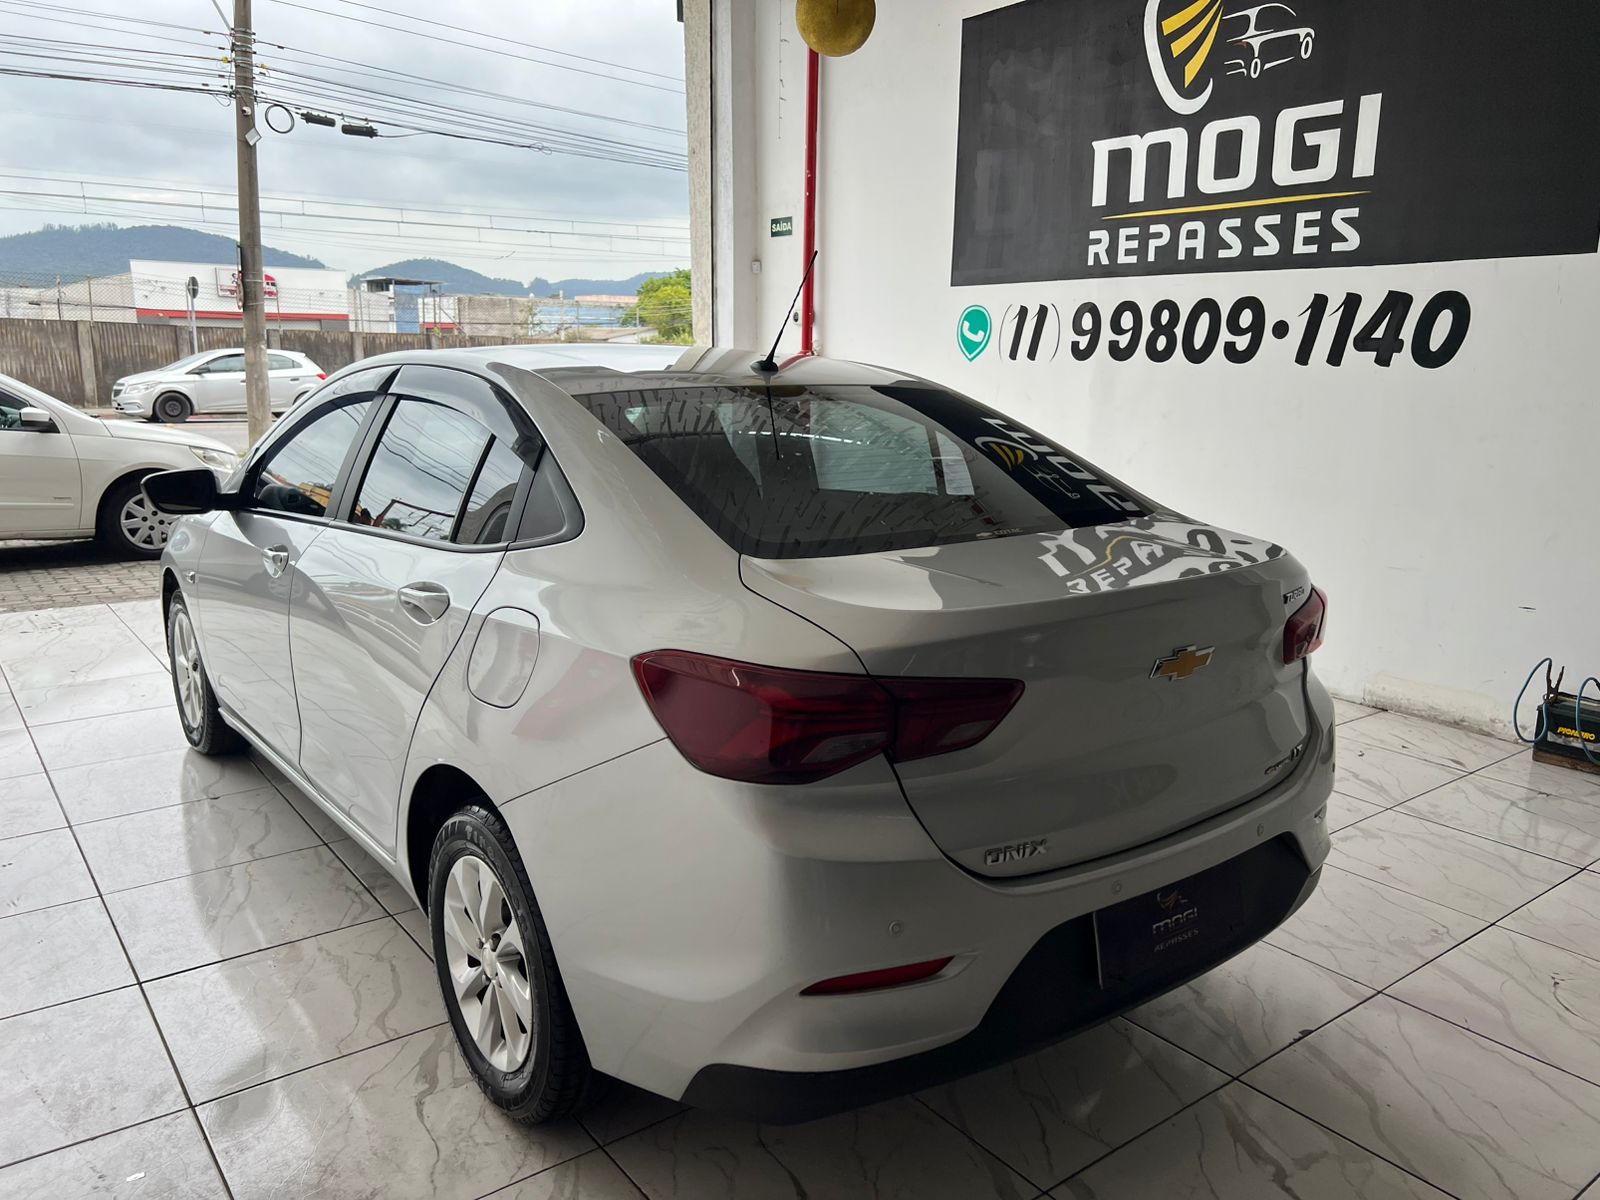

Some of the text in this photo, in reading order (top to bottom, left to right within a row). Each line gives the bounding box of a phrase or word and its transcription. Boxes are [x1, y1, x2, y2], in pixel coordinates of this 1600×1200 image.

[1091, 92, 1383, 207] MOGI
[771, 220, 792, 232] SAÍDA
[1086, 206, 1362, 267] REPASSES
[998, 302, 1061, 363] (11)
[984, 838, 1048, 866] ONIX
